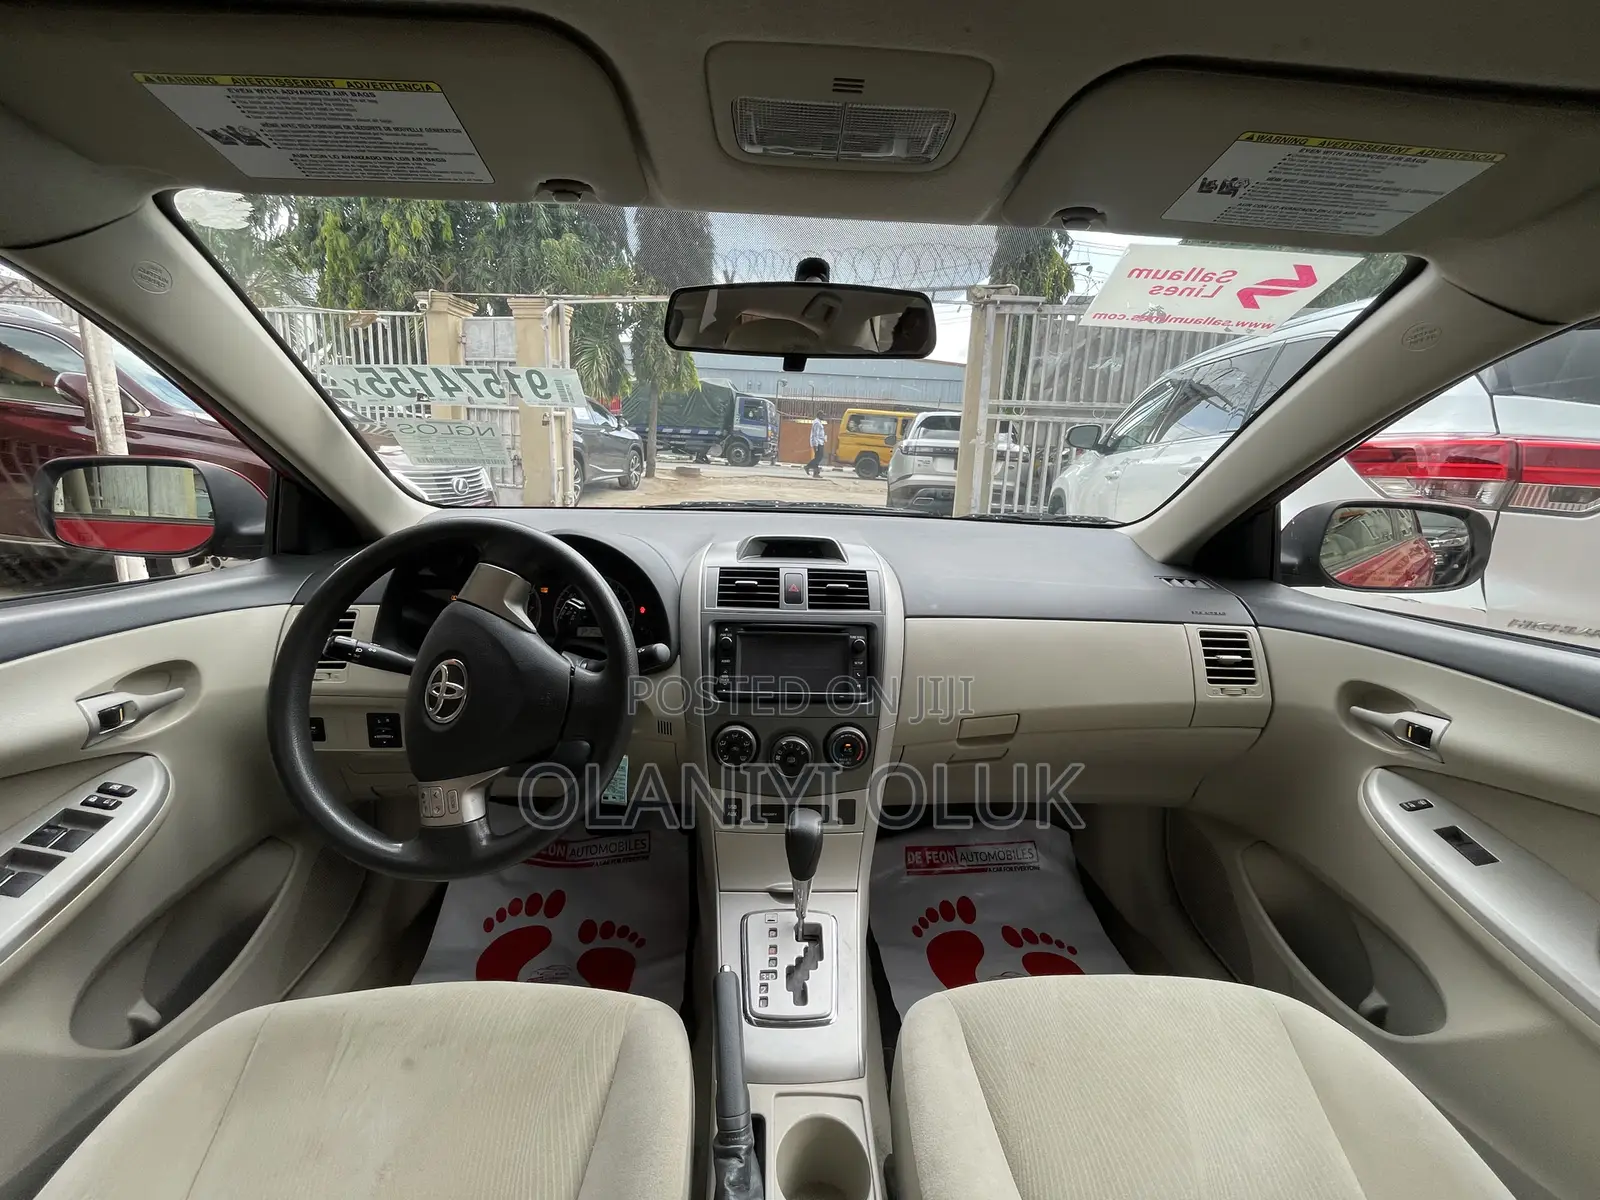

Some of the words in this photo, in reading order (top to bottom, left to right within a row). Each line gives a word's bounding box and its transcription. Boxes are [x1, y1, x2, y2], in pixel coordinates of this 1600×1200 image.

[154, 75, 218, 85] WARNING
[230, 76, 336, 88] AVERTISSEMENT
[345, 80, 433, 92] ADVERTENCIA
[1256, 134, 1309, 146] WARNING
[1317, 140, 1413, 155] AVERTISSEMENT
[1416, 149, 1498, 161] ADVERTENCIA
[568, 838, 647, 857] AUTOMOBILES
[907, 851, 922, 864] DE
[926, 850, 957, 864] FEON
[960, 848, 1035, 863] AUTOMOBILES
